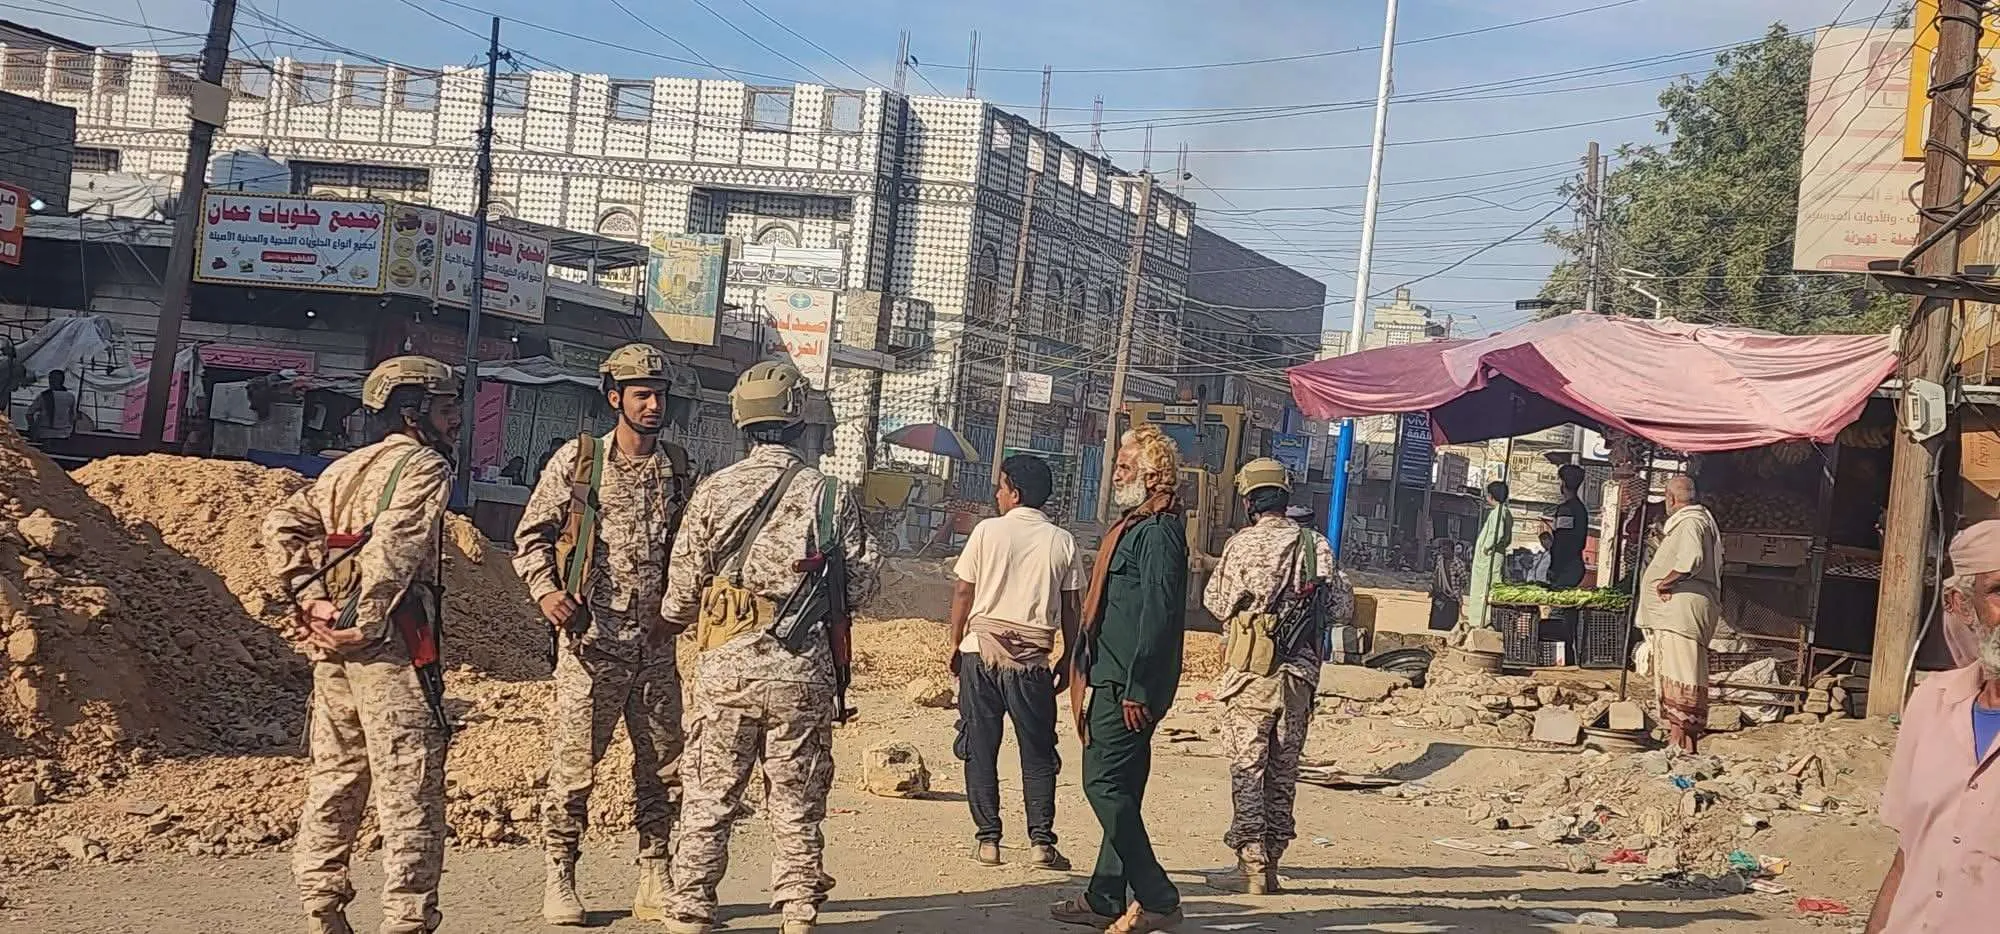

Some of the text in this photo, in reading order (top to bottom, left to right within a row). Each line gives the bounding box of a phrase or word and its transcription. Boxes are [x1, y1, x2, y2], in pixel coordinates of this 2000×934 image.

[207, 198, 381, 232] مجمع حلويات عمان
[299, 236, 331, 249] الحلويات
[444, 220, 545, 264] مجمع حلويا عمان
